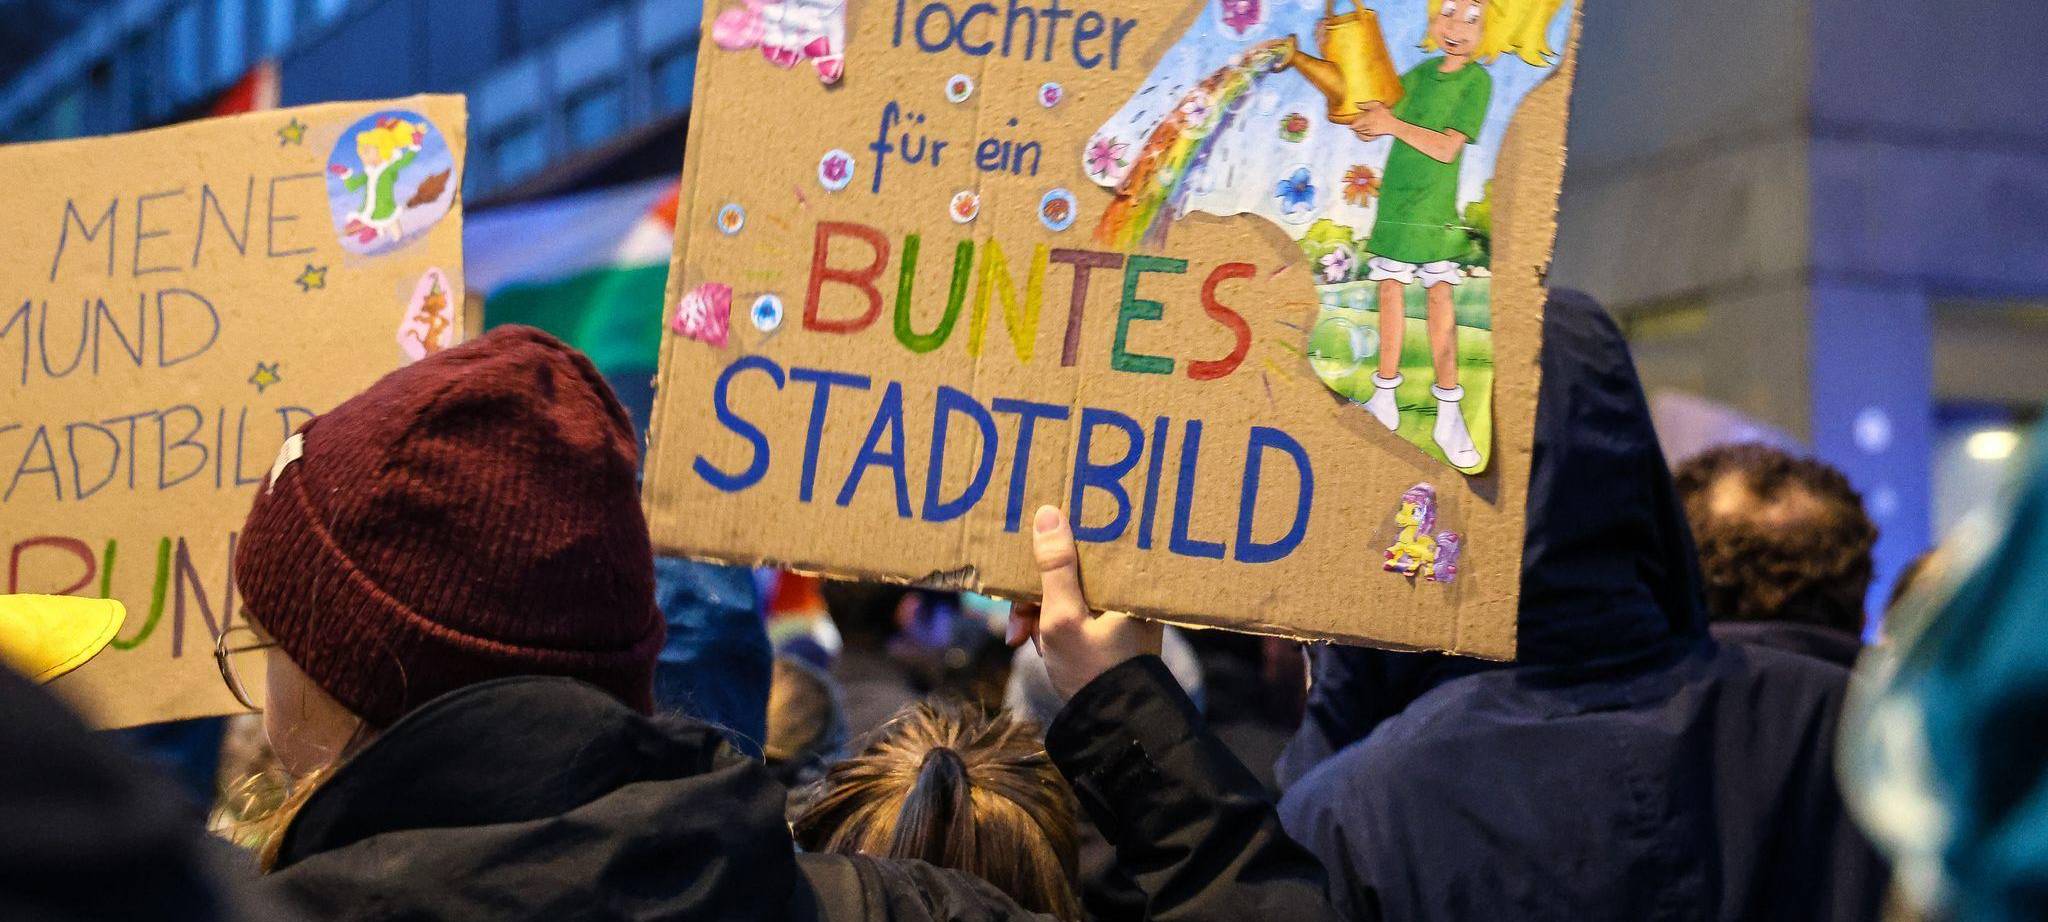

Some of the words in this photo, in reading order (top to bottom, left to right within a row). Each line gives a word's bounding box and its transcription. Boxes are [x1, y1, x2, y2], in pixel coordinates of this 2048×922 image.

[869, 100, 945, 193] für
[975, 118, 1042, 176] ein
[50, 172, 324, 282] MENE
[802, 221, 1257, 381] BUNTES
[0, 403, 318, 503] ADTBIL
[692, 355, 1314, 563] STADTBILD
